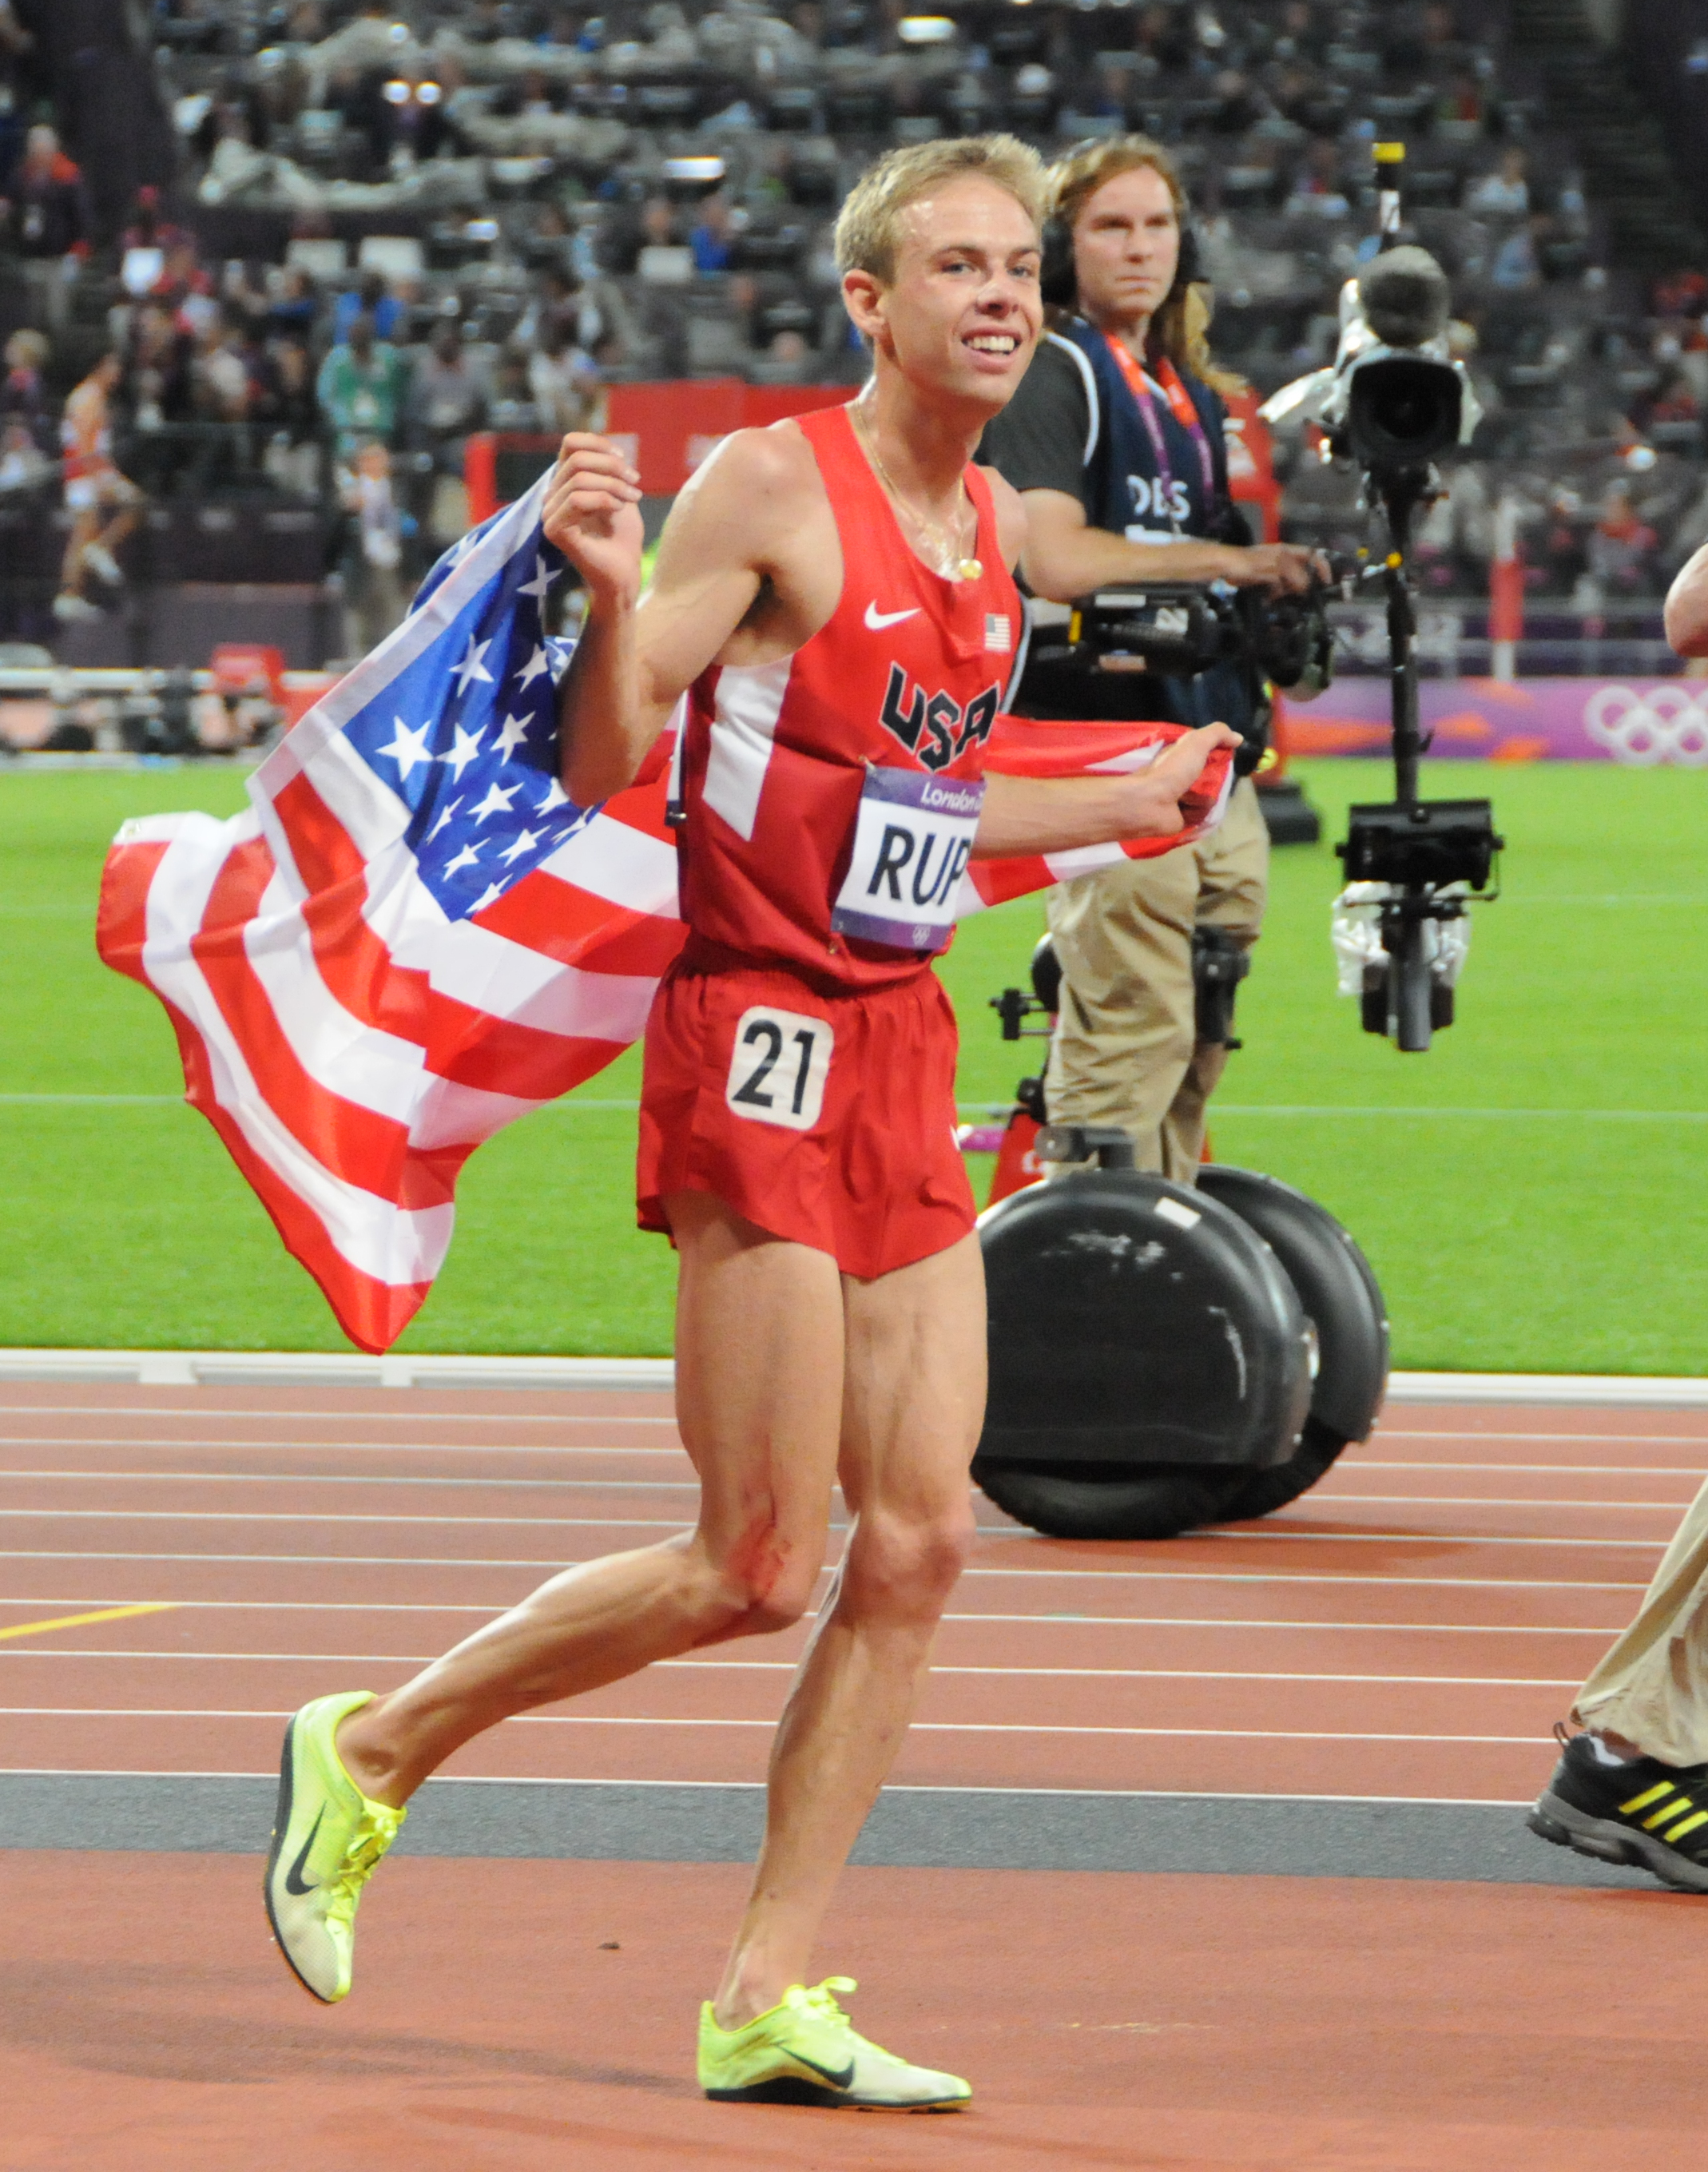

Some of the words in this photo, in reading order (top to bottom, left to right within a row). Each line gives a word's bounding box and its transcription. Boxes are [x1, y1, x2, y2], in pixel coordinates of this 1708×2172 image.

[879, 660, 1000, 773] USA
[920, 780, 976, 812] London
[732, 1018, 816, 1115] 21
